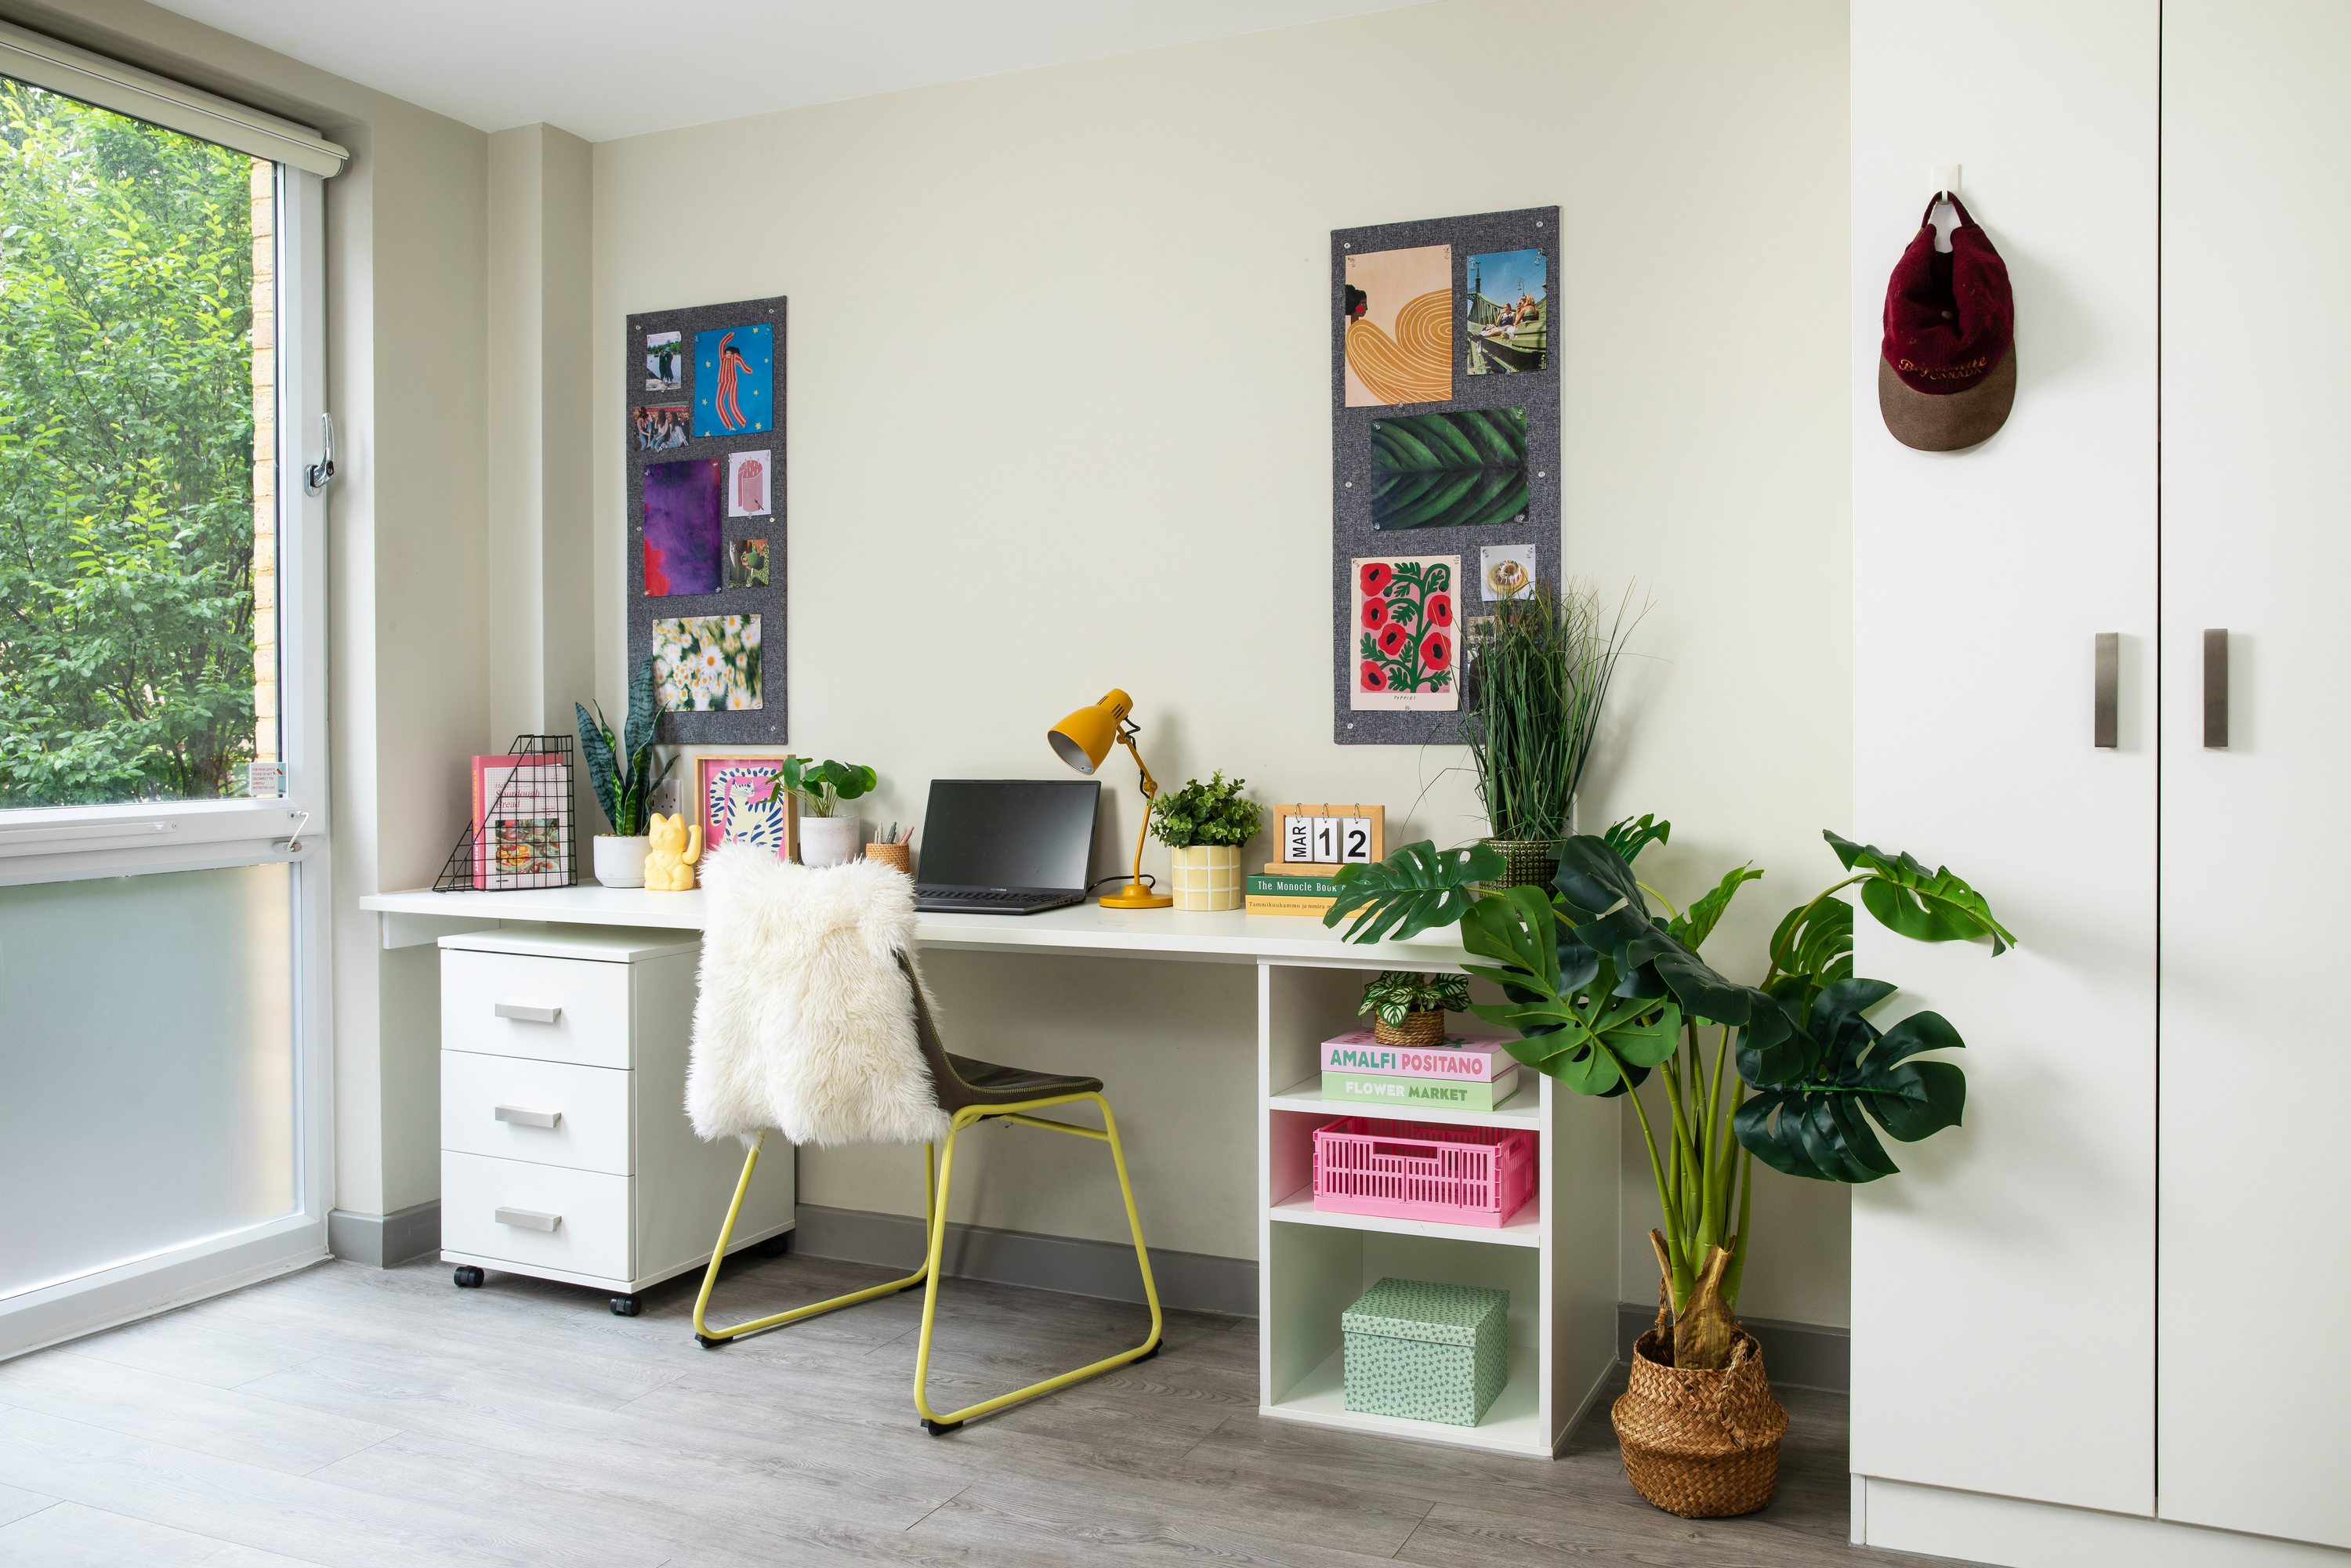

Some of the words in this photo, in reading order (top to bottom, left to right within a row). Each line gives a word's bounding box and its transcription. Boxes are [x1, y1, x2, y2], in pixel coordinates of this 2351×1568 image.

[1929, 368, 1983, 380] CANADA
[495, 789, 540, 799] Sourdough
[1292, 826, 1306, 857] MAR
[1319, 827, 1331, 856] 1
[1347, 830, 1367, 857] 2
[1258, 881, 1273, 890] The
[1277, 882, 1312, 891] Monocle
[1317, 882, 1337, 892] Book
[1330, 1049, 1396, 1070] AMALFI
[1401, 1053, 1483, 1075] POSITANO
[1346, 1081, 1405, 1097] FLOWER
[1408, 1085, 1468, 1101] MARKET
